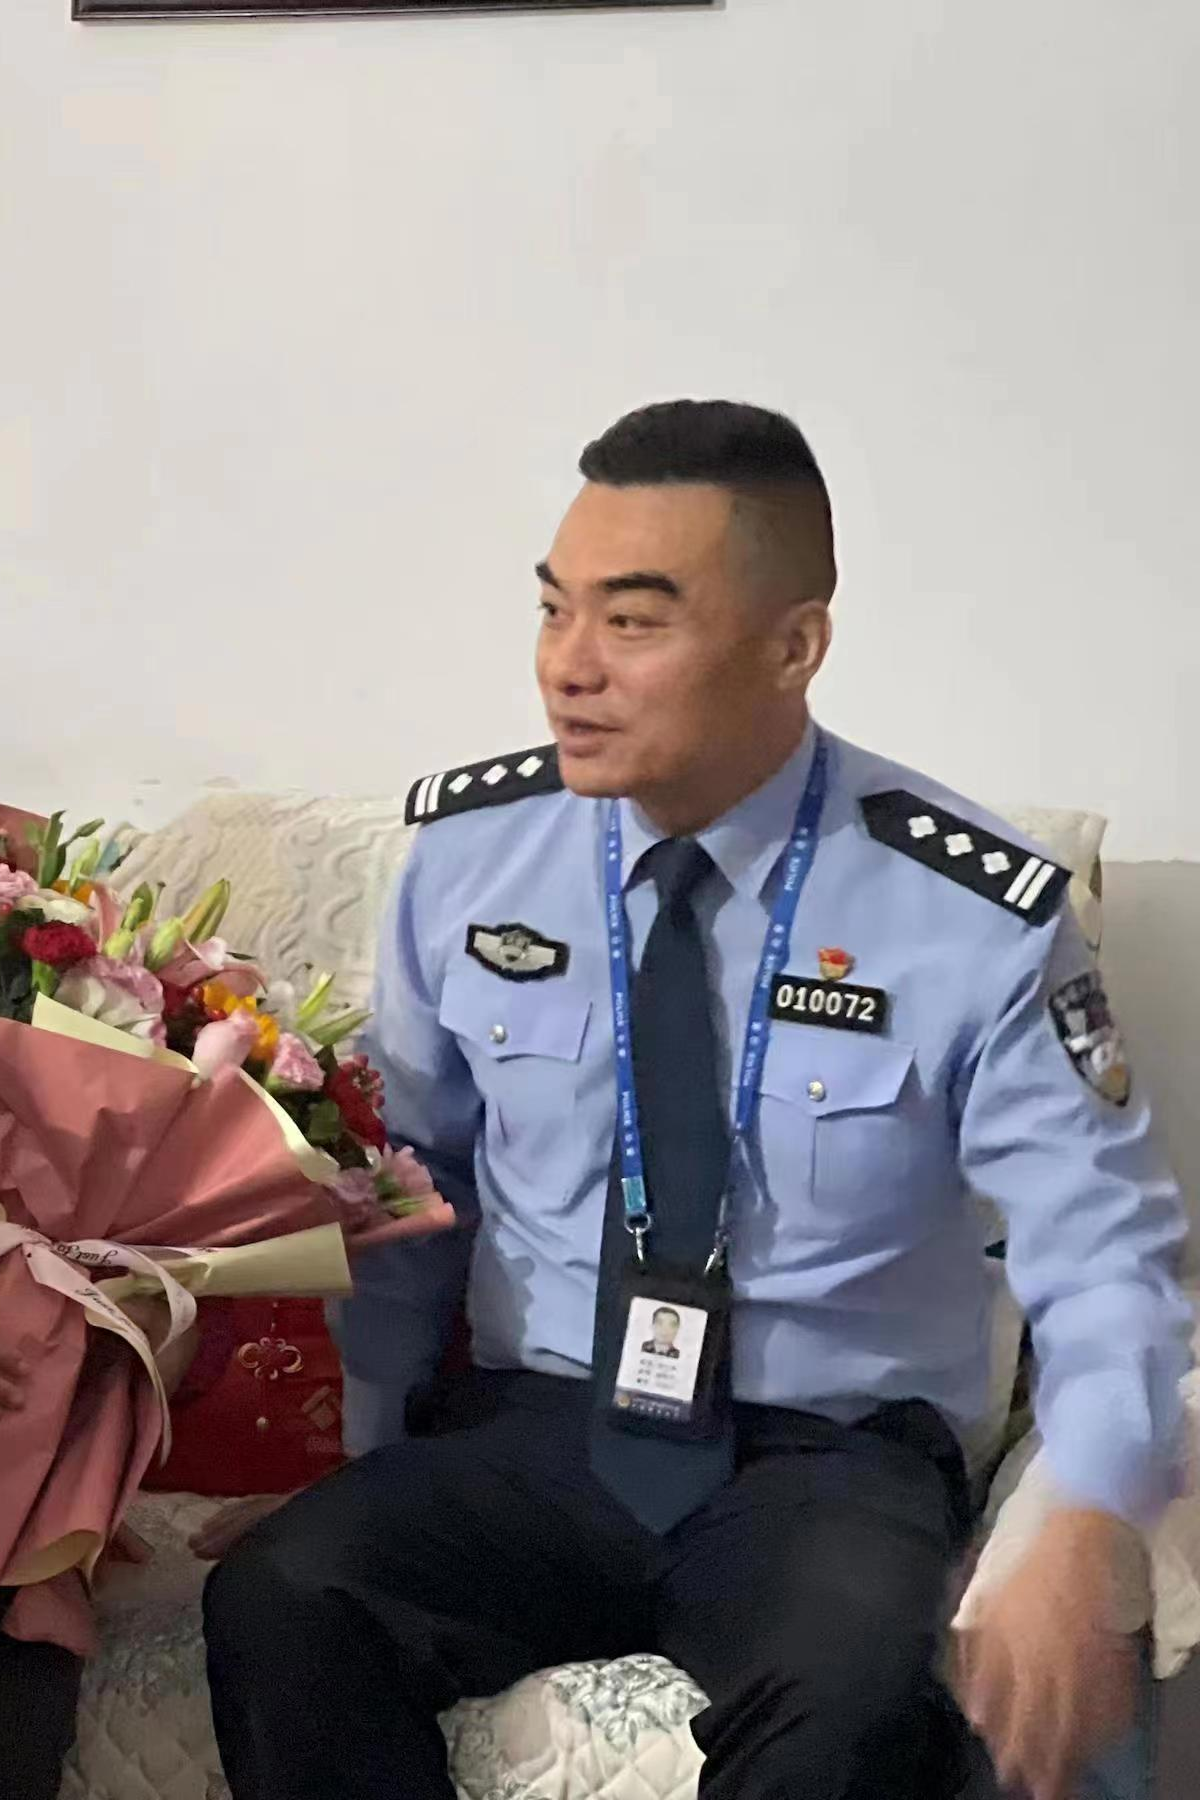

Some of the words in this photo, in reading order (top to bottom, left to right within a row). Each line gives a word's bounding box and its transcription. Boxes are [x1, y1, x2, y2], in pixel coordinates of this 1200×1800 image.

[784, 857, 801, 891] POLICE
[615, 992, 625, 1027] POLICE
[776, 984, 876, 1022] 010072
[622, 1091, 633, 1127] POLICE
